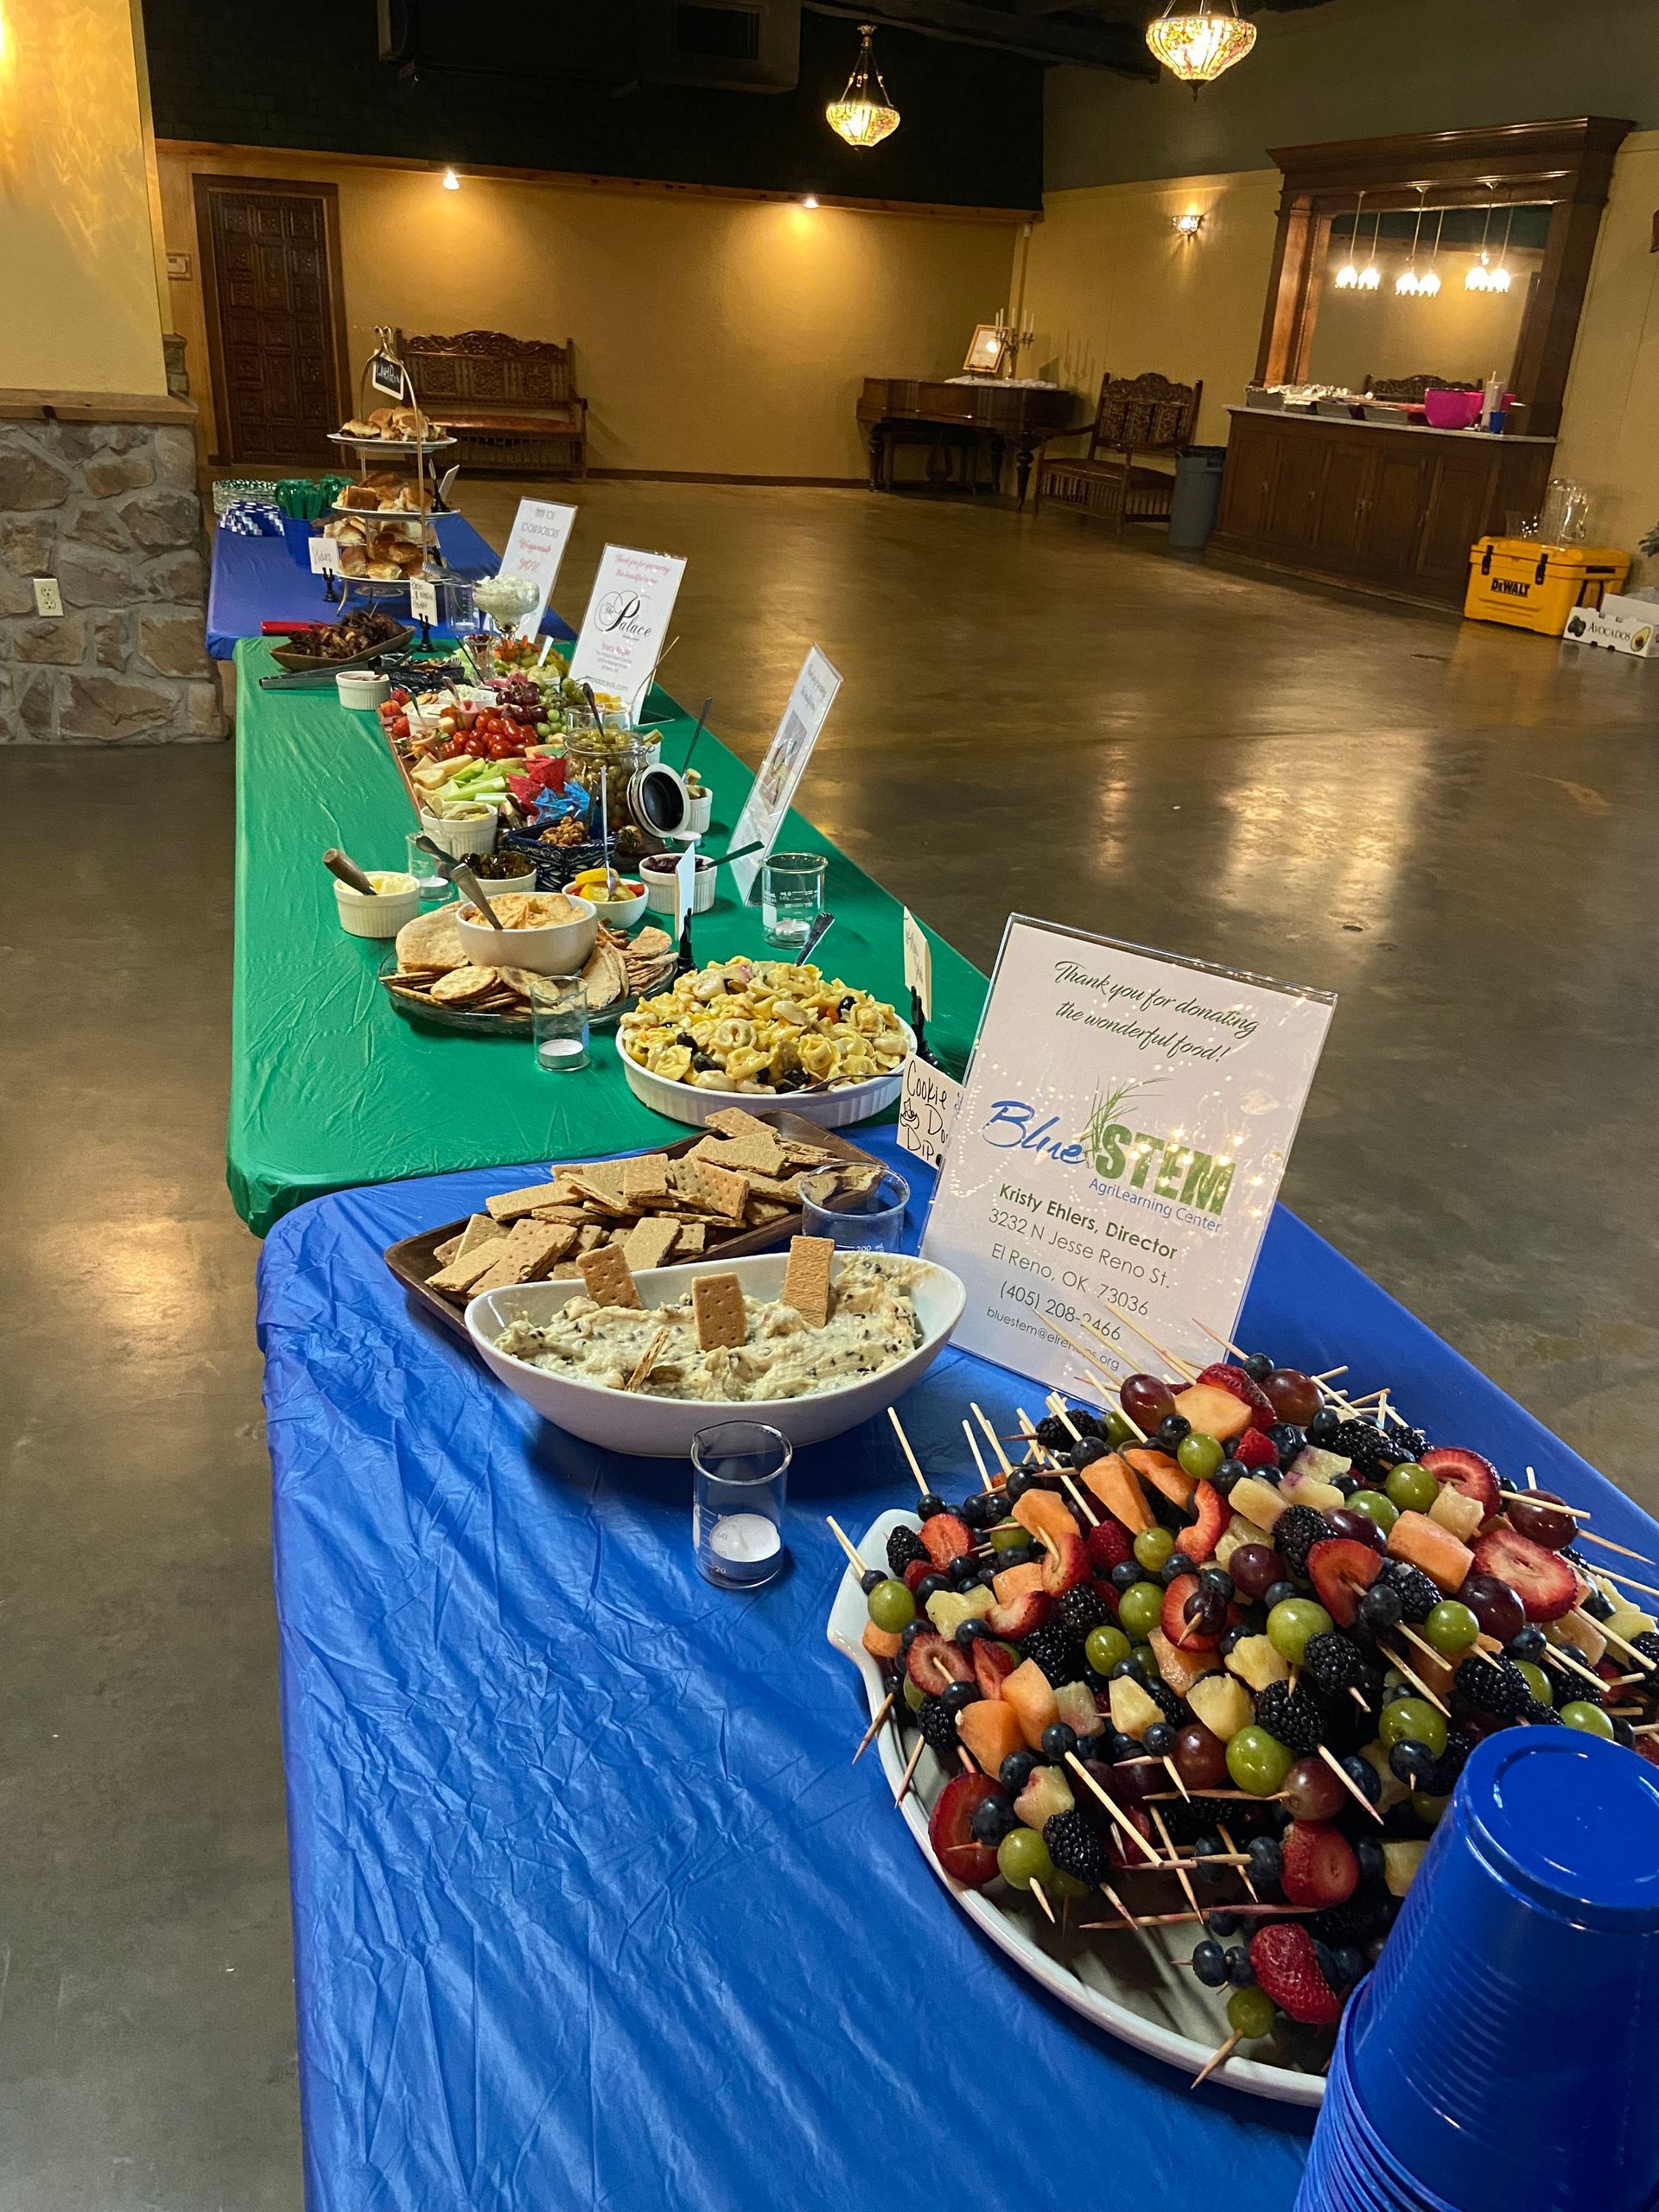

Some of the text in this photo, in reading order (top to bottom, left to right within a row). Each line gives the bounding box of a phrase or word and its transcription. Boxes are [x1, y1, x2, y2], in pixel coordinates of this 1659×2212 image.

[596, 591, 651, 637] Palace
[1587, 621, 1631, 641] AVOCADOS
[1054, 961, 1260, 1039] Thank you for donating
[1055, 1001, 1231, 1063] the wonderful food!
[907, 1060, 947, 1110] Cookie
[982, 1100, 1236, 1216] Blue STEM
[999, 1183, 1178, 1260] Kristy Ehlers, Director
[1089, 1177, 1222, 1233] AgriLearning Center
[988, 1207, 1170, 1289] 3232 N Jesse Reno St.
[991, 1243, 1149, 1316] El Reno, OK 73036
[1000, 1280, 1040, 1310] (405)
